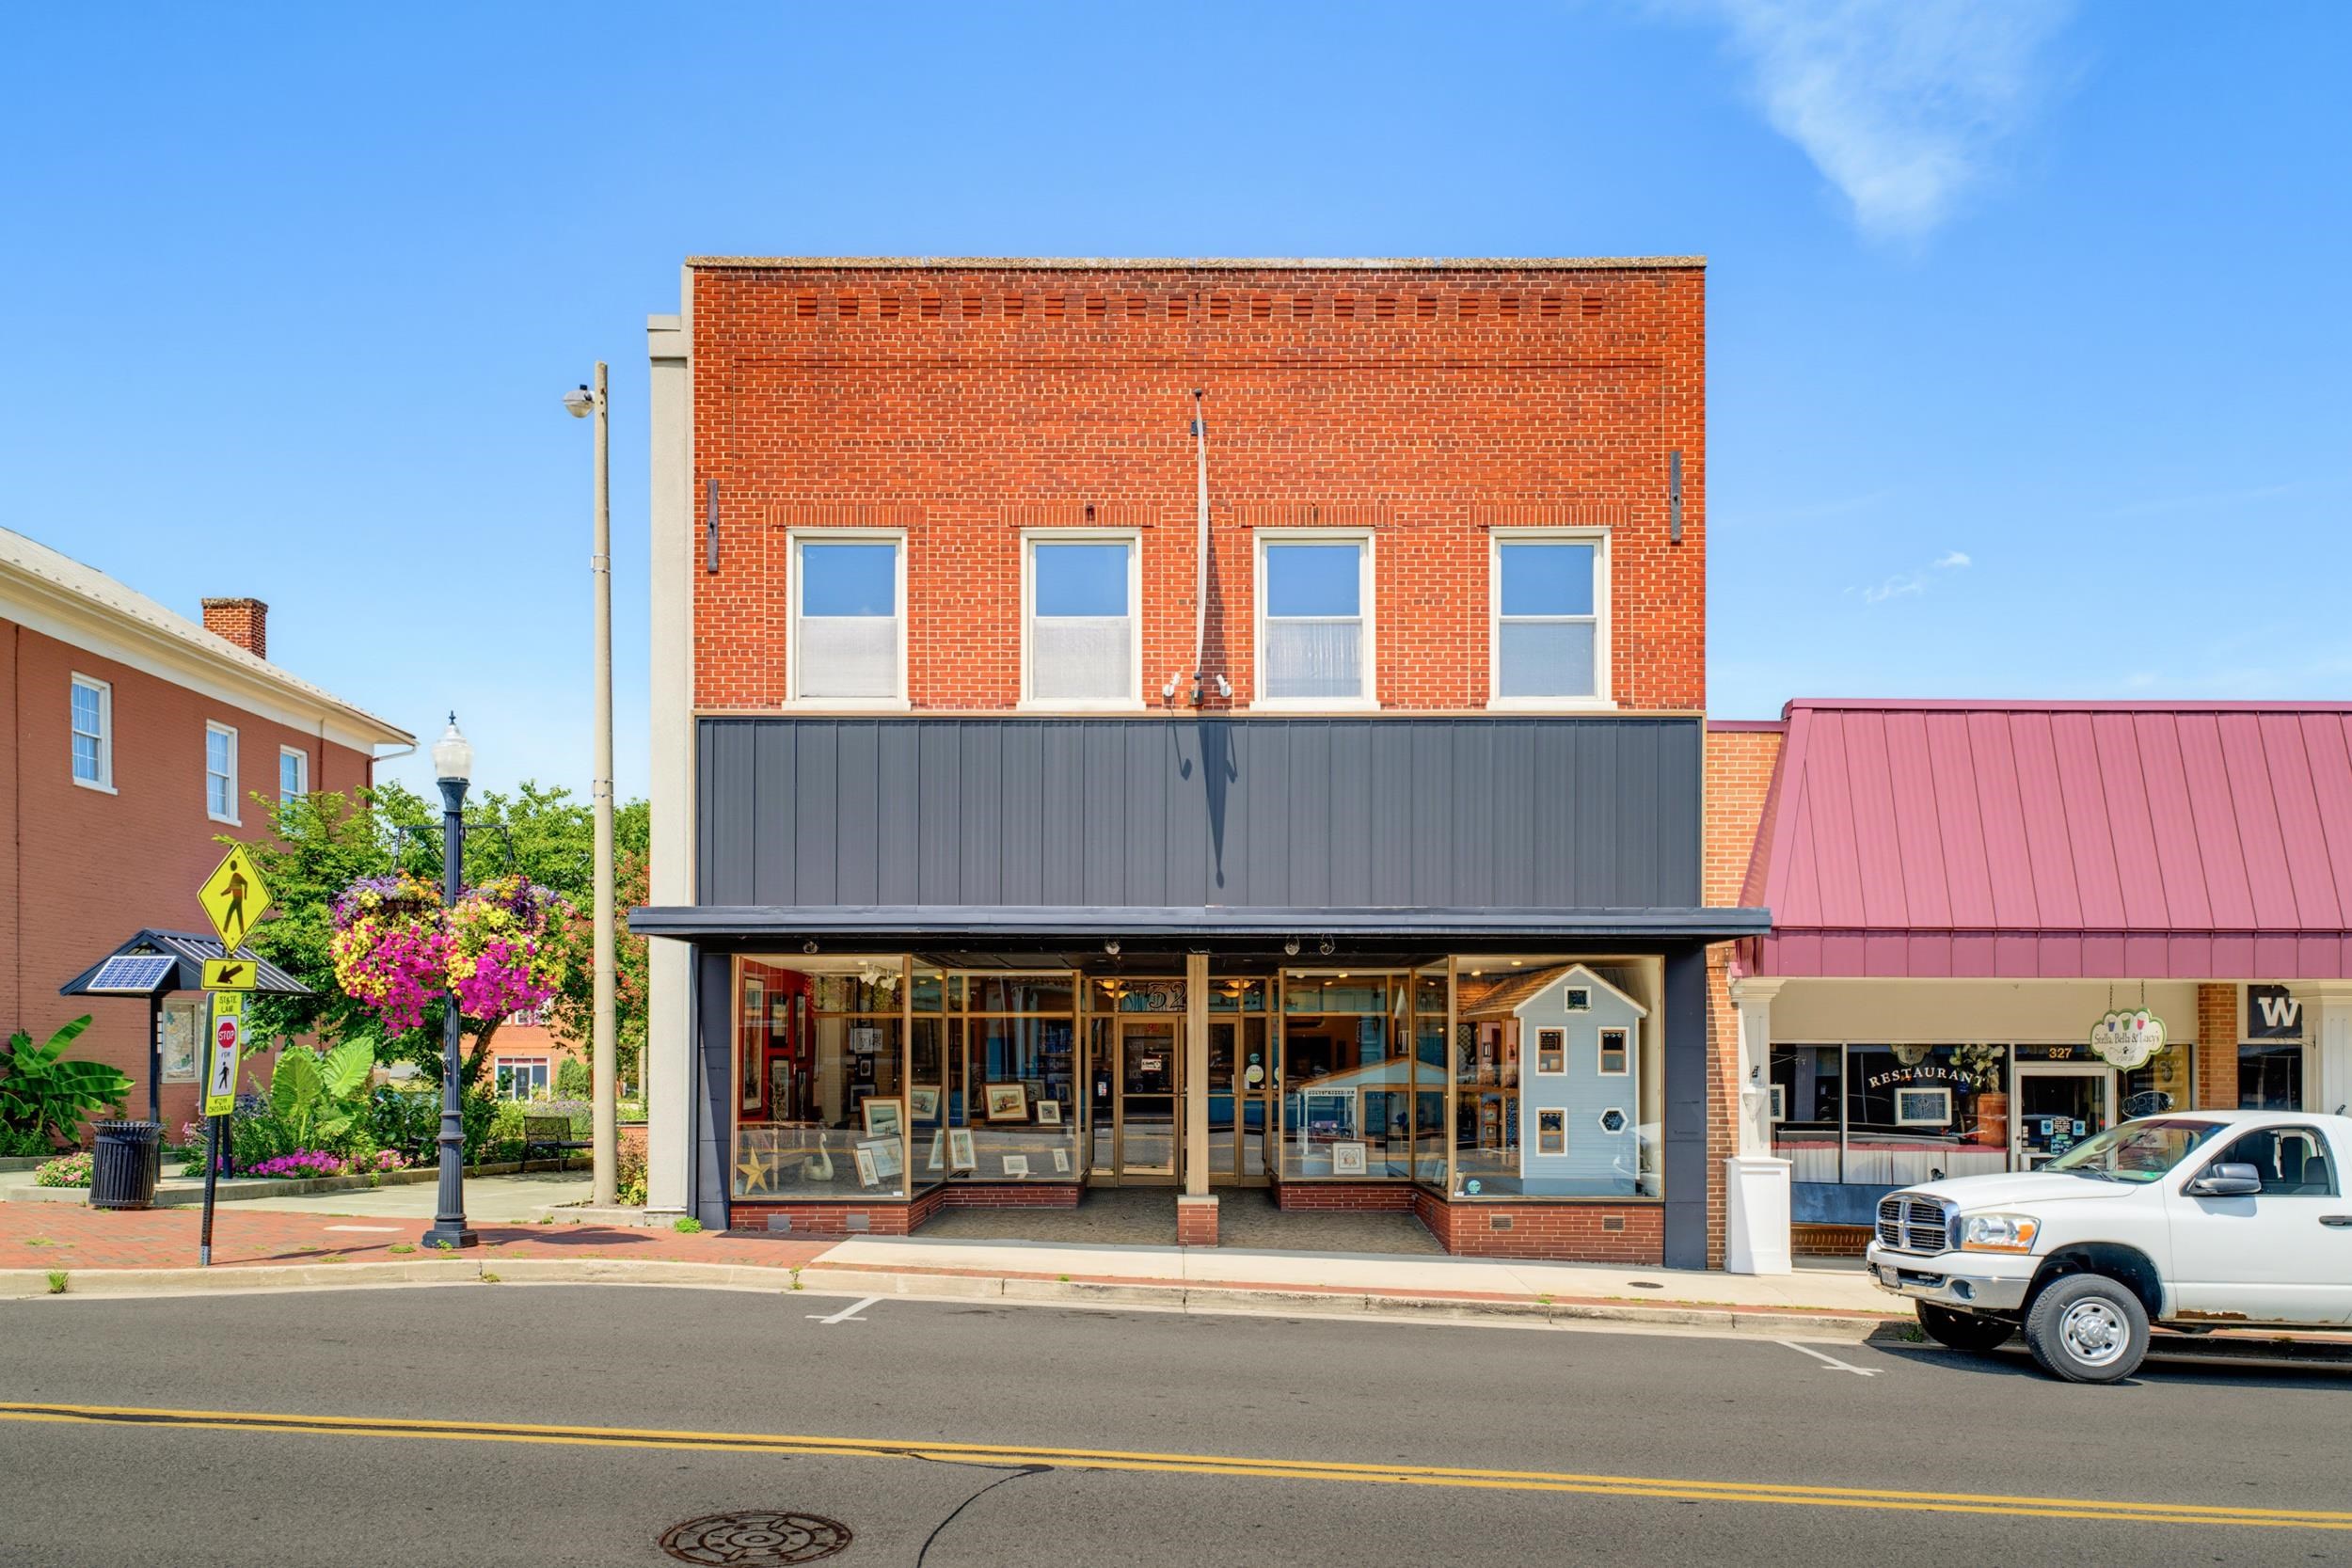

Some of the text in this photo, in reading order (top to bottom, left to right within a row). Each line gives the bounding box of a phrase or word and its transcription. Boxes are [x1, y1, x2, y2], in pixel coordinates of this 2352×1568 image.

[218, 995, 237, 1005] STATE
[2258, 996, 2300, 1027] W
[218, 1031, 234, 1040] STOP
[2115, 1032, 2130, 1043] Bella
[2131, 1032, 2138, 1043] &
[2049, 1047, 2072, 1059] 327
[1868, 1067, 1985, 1088] RESTAURANT
[2122, 1095, 2169, 1114] OPEN
